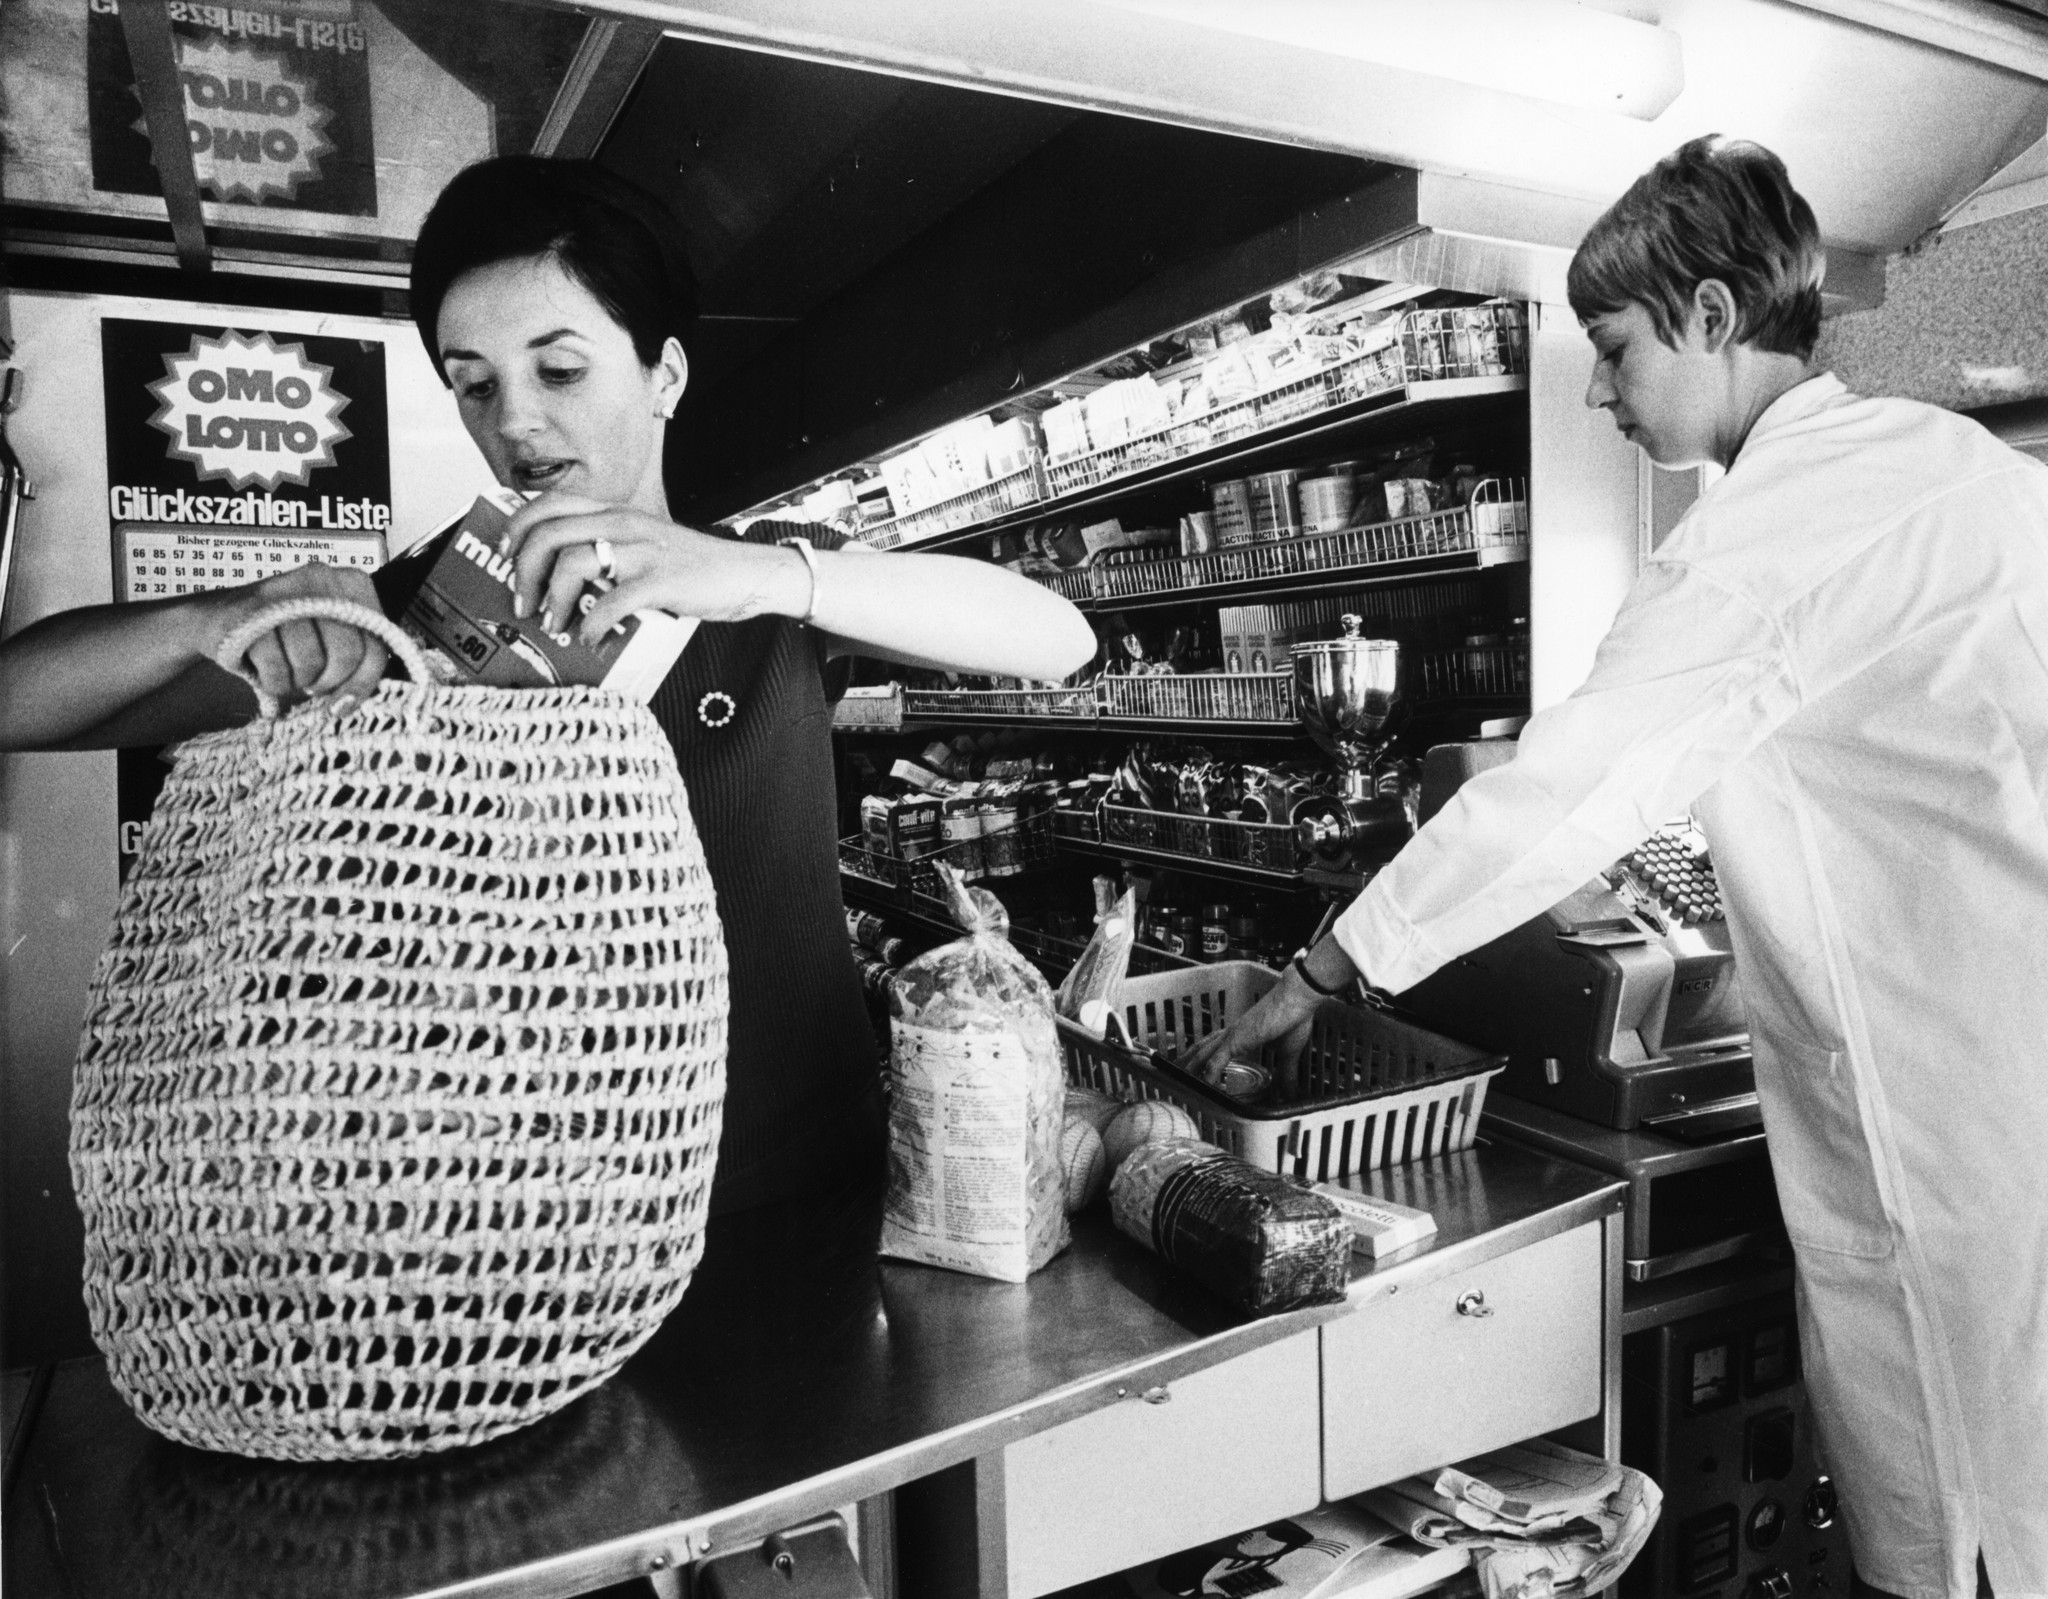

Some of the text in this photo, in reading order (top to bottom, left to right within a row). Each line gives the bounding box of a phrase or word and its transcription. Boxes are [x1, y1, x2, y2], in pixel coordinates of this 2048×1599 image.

[188, 367, 312, 409] OMO
[186, 413, 318, 454] LOTTO
[110, 485, 391, 531] Glückszahlen-Liste
[177, 534, 334, 550] Bisher gezogene Glückszahlen:
[133, 548, 145, 558] 66
[153, 549, 166, 559] 85
[173, 549, 184, 559] 57
[192, 550, 204, 560] 35
[212, 551, 224, 560] 47
[231, 551, 244, 561] 65
[254, 552, 262, 561] 11
[269, 552, 282, 562] 50
[294, 554, 300, 563] 8
[327, 554, 338, 563] 74
[350, 556, 356, 564] 6
[362, 556, 374, 565] 23
[136, 565, 146, 575] 19
[153, 566, 166, 576] 40
[175, 567, 185, 576] 51
[193, 567, 205, 577] 80
[212, 568, 224, 577] 88
[232, 568, 244, 578] 30
[256, 569, 263, 579] 9
[134, 583, 147, 593] 28
[154, 583, 166, 593] 32
[1683, 980, 1711, 992] NCR
